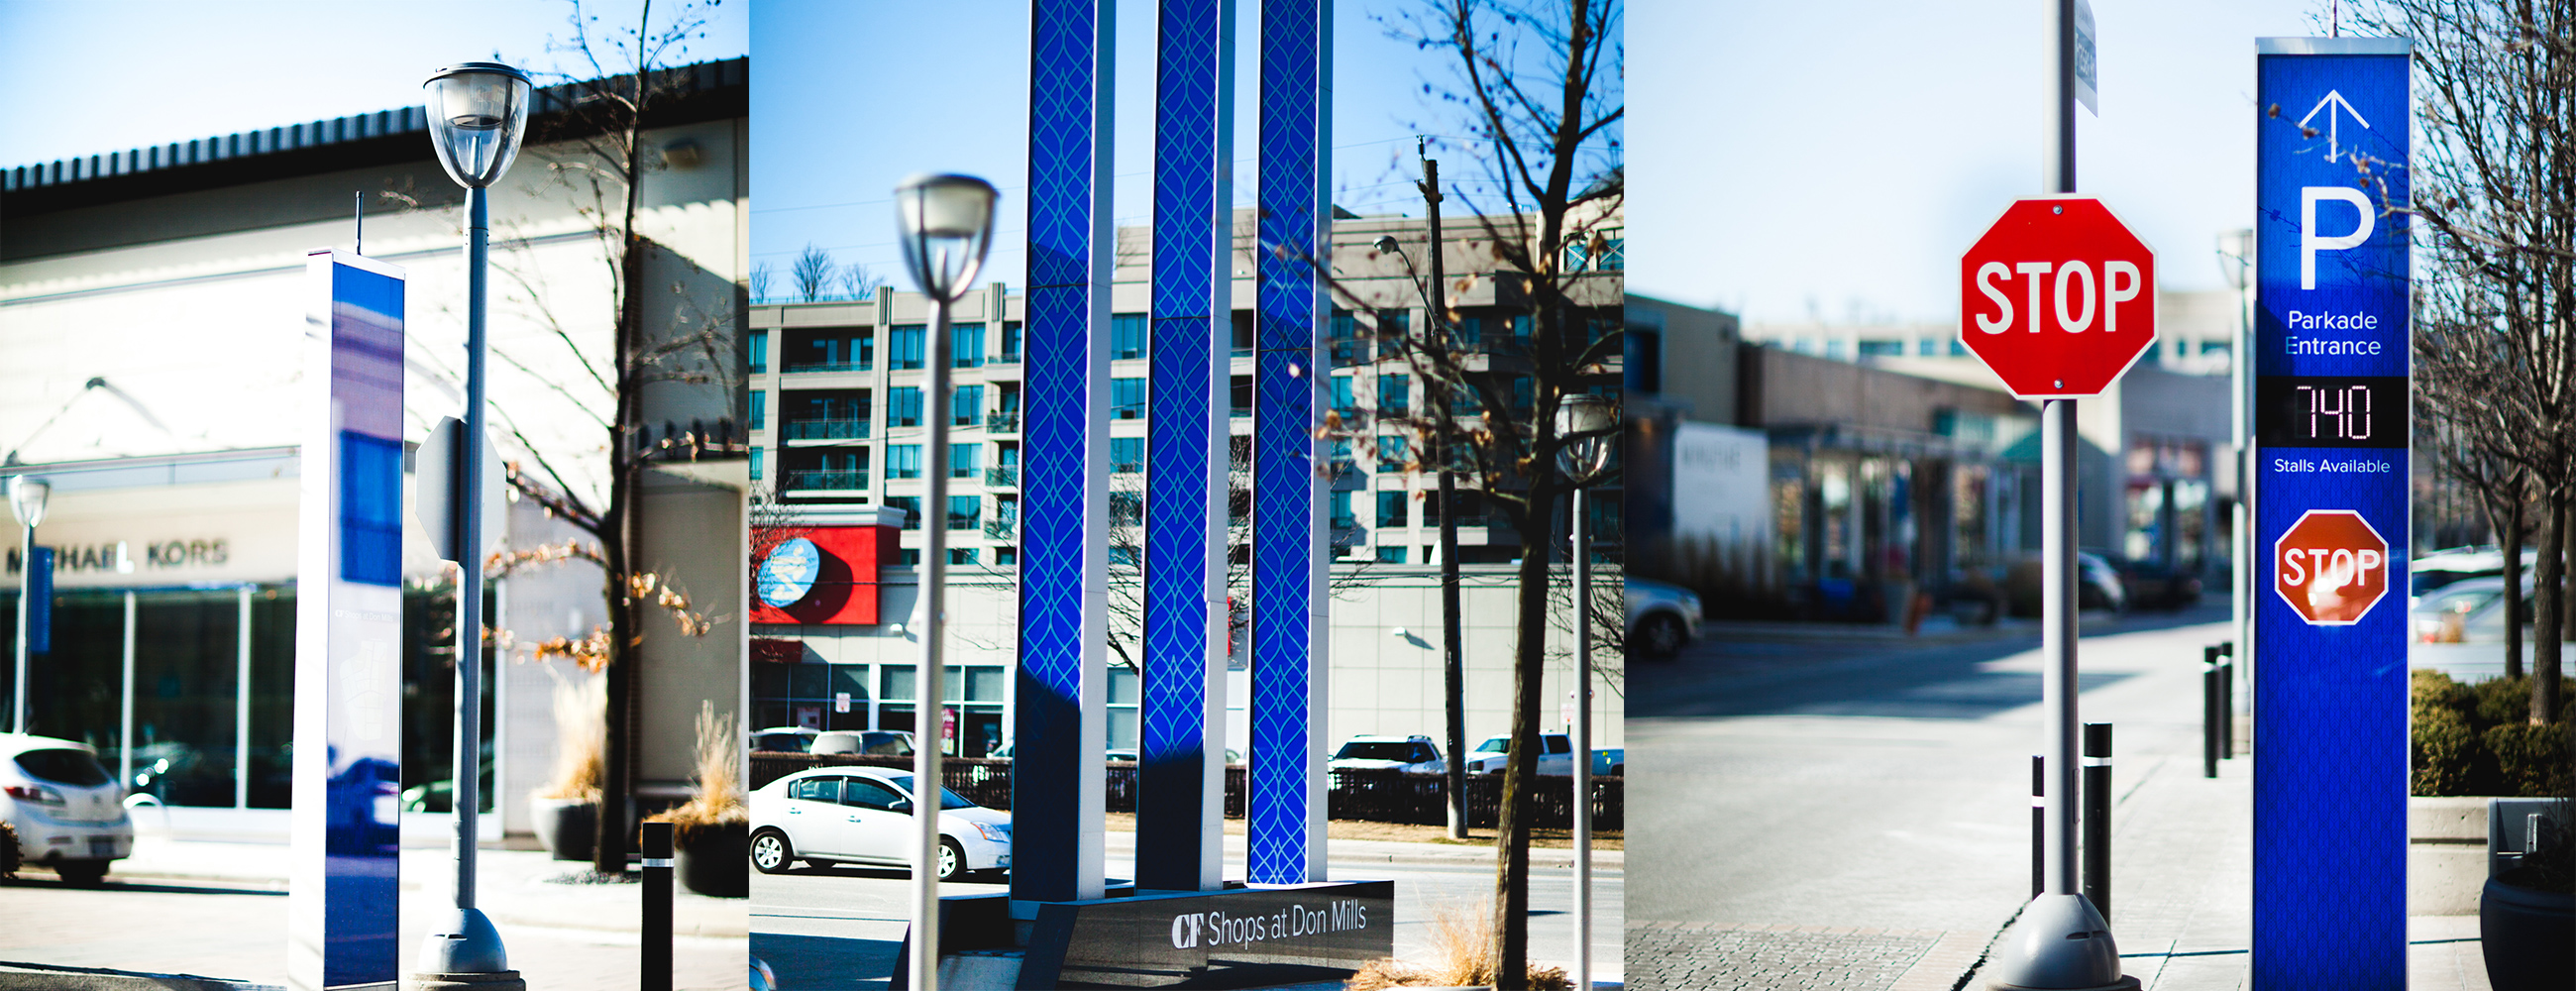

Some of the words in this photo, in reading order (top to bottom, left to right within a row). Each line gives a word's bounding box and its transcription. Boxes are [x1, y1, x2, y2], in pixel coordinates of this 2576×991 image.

[2301, 186, 2375, 290] P
[1976, 260, 2141, 335] STOP
[2289, 310, 2378, 330] Parkade
[2286, 336, 2382, 355] Entrance
[2297, 385, 2371, 439] 740
[2274, 458, 2315, 474] Stalls
[2319, 459, 2391, 474] Available
[147, 538, 228, 568] KORS
[2283, 547, 2382, 588] STOP
[1172, 913, 1204, 949] CF
[1208, 911, 1266, 950] Shops
[1271, 908, 1287, 939] at
[1293, 904, 1327, 936] Don
[1332, 899, 1366, 932] Mills
